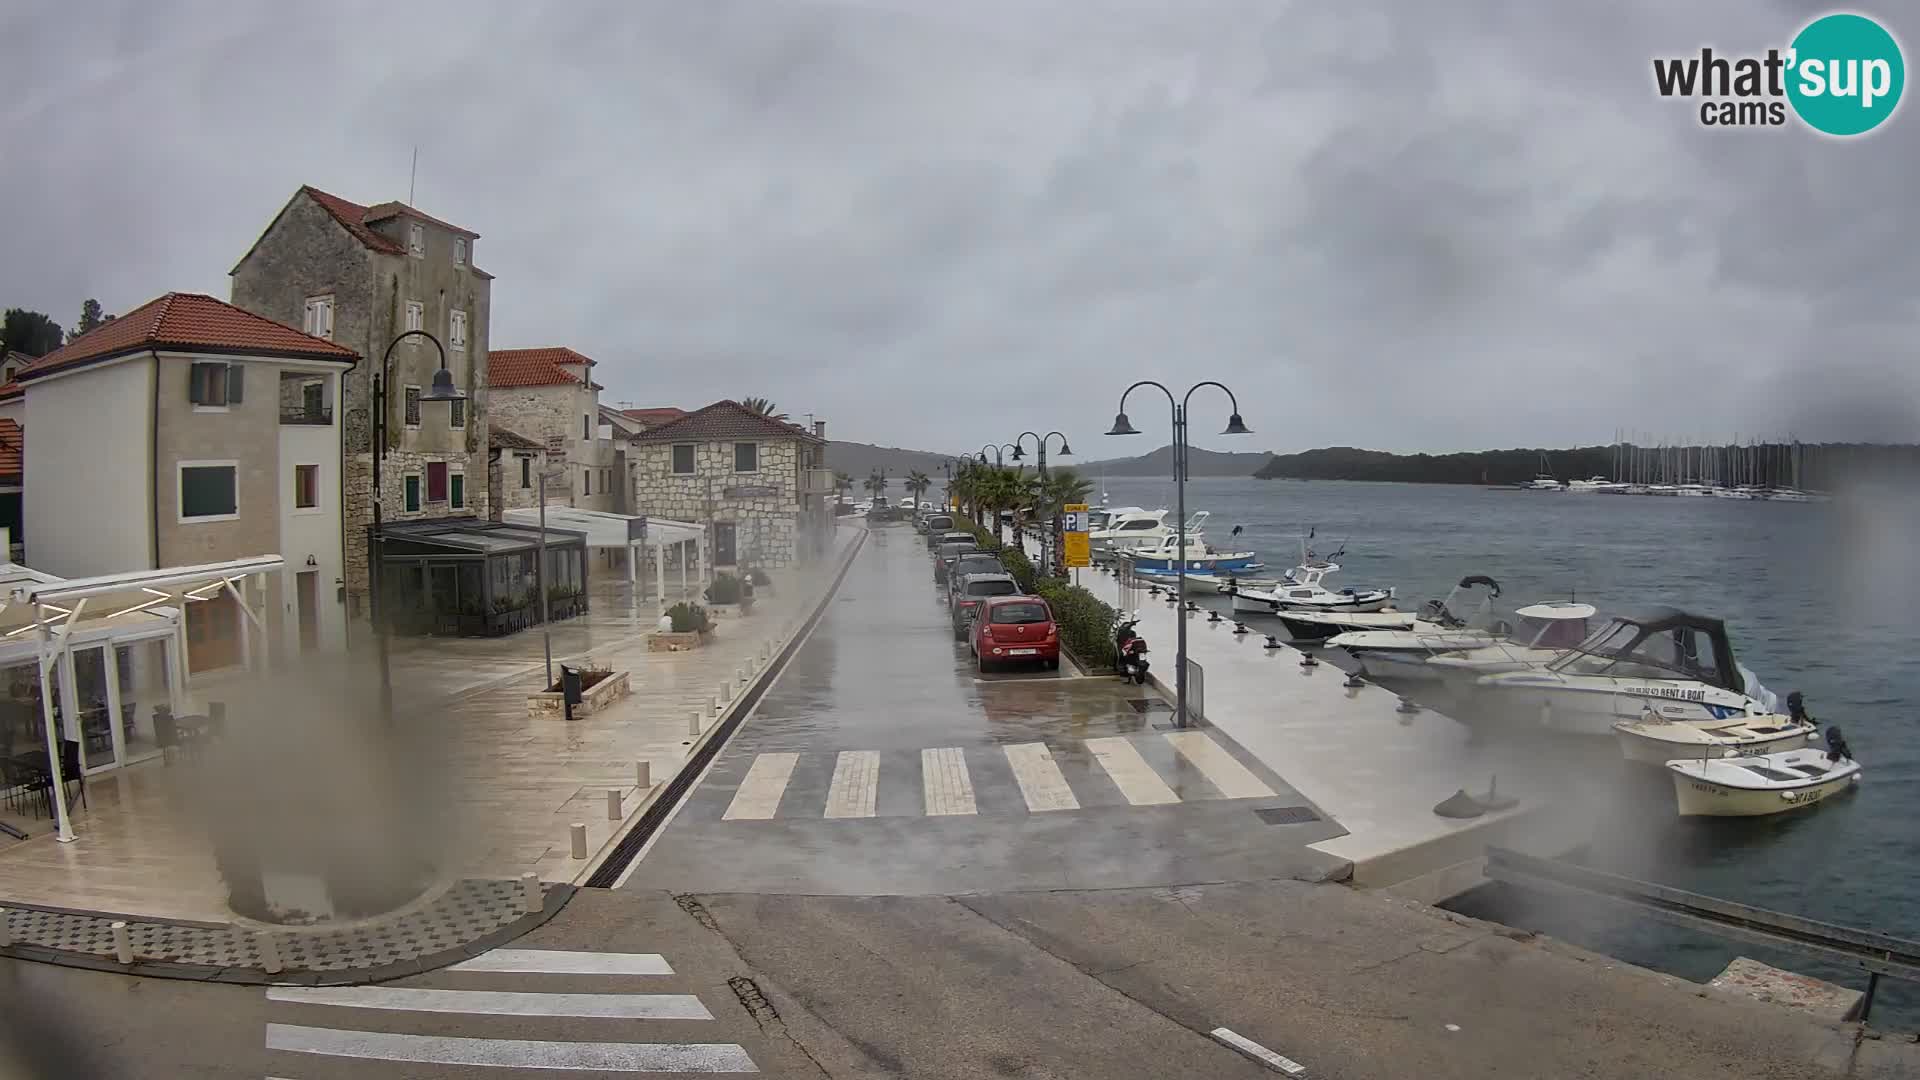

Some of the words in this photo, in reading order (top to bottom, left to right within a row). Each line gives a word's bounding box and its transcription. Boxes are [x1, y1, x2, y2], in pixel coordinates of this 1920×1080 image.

[1066, 514, 1076, 530] P
[1660, 688, 1680, 698] RENT
[1687, 690, 1706, 701] BOAT
